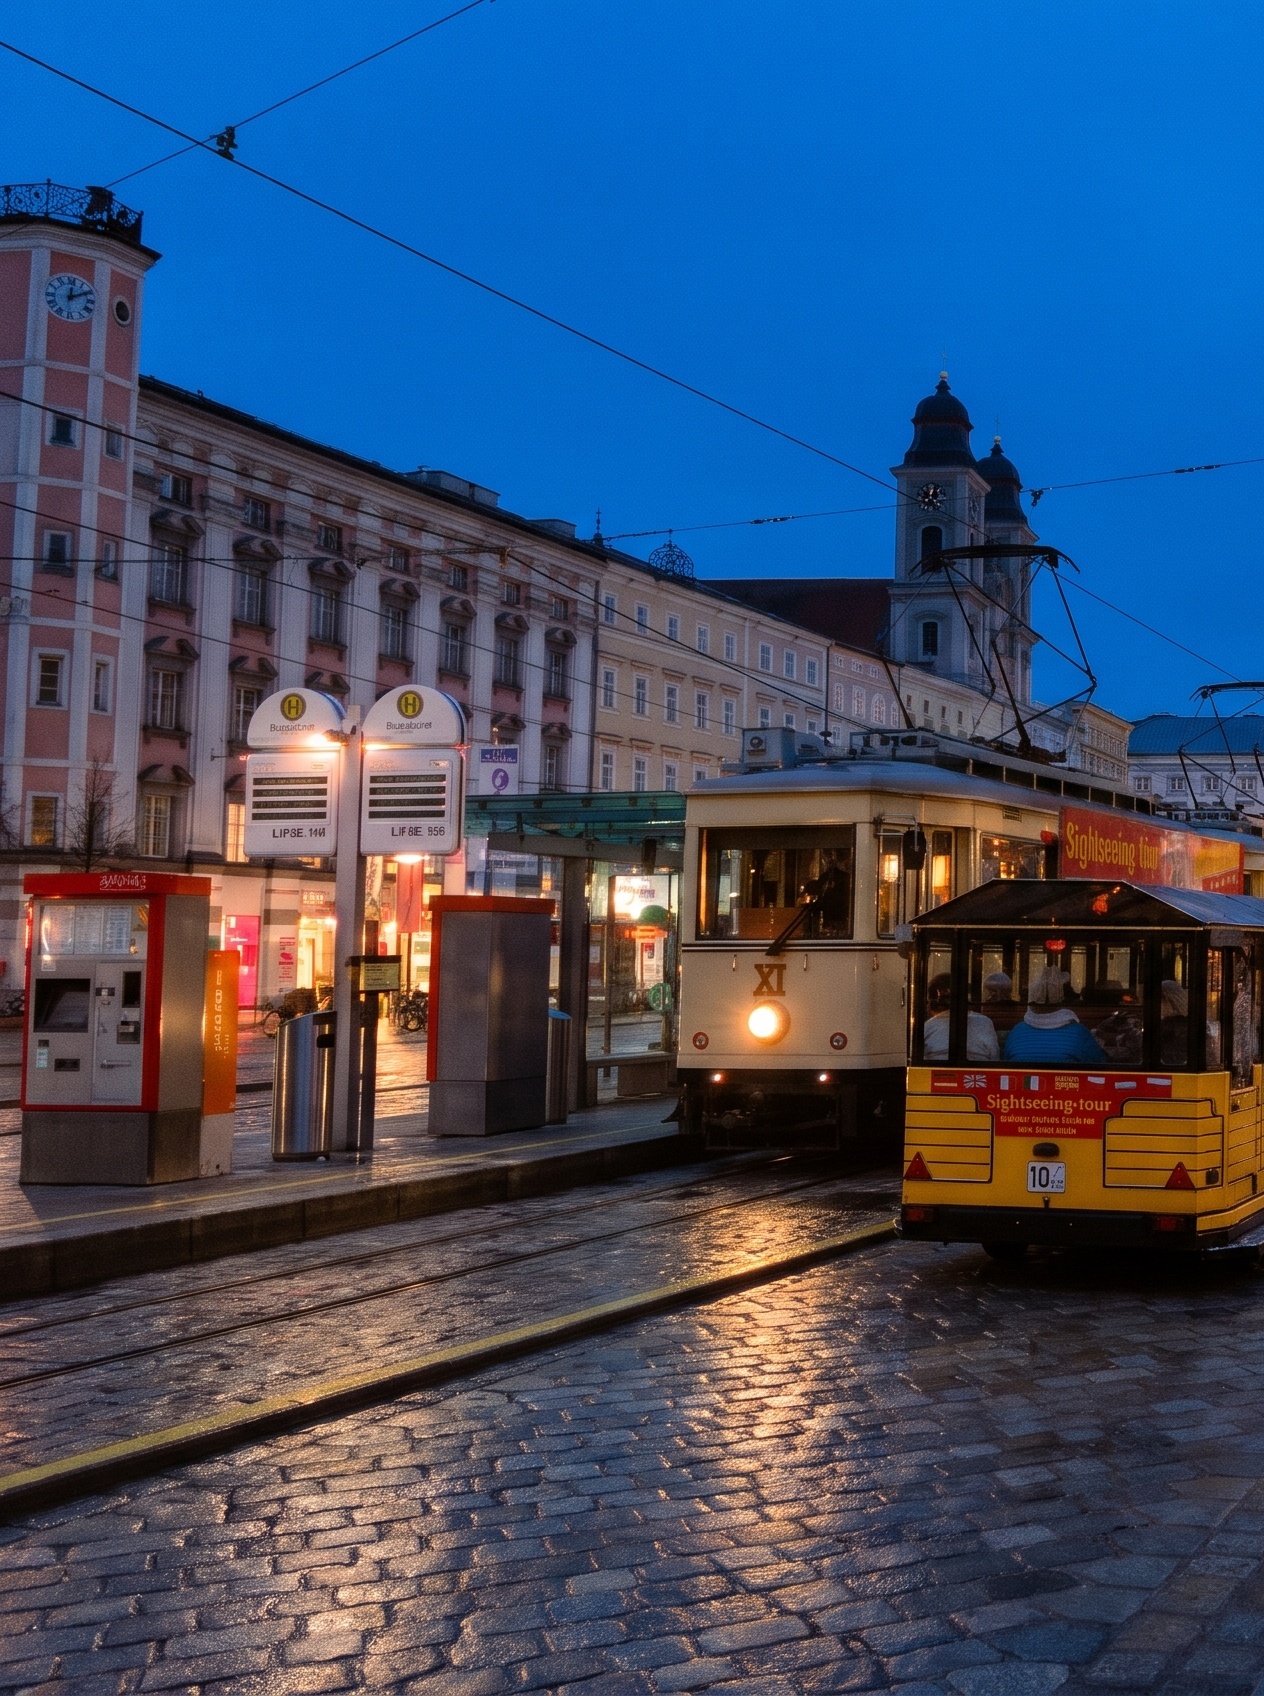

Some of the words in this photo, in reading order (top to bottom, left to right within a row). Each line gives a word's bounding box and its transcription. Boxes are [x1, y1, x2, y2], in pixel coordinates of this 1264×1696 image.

[287, 699, 300, 717] H
[404, 696, 417, 714] H
[753, 963, 787, 996] XI
[1030, 1166, 1050, 1188] 10
